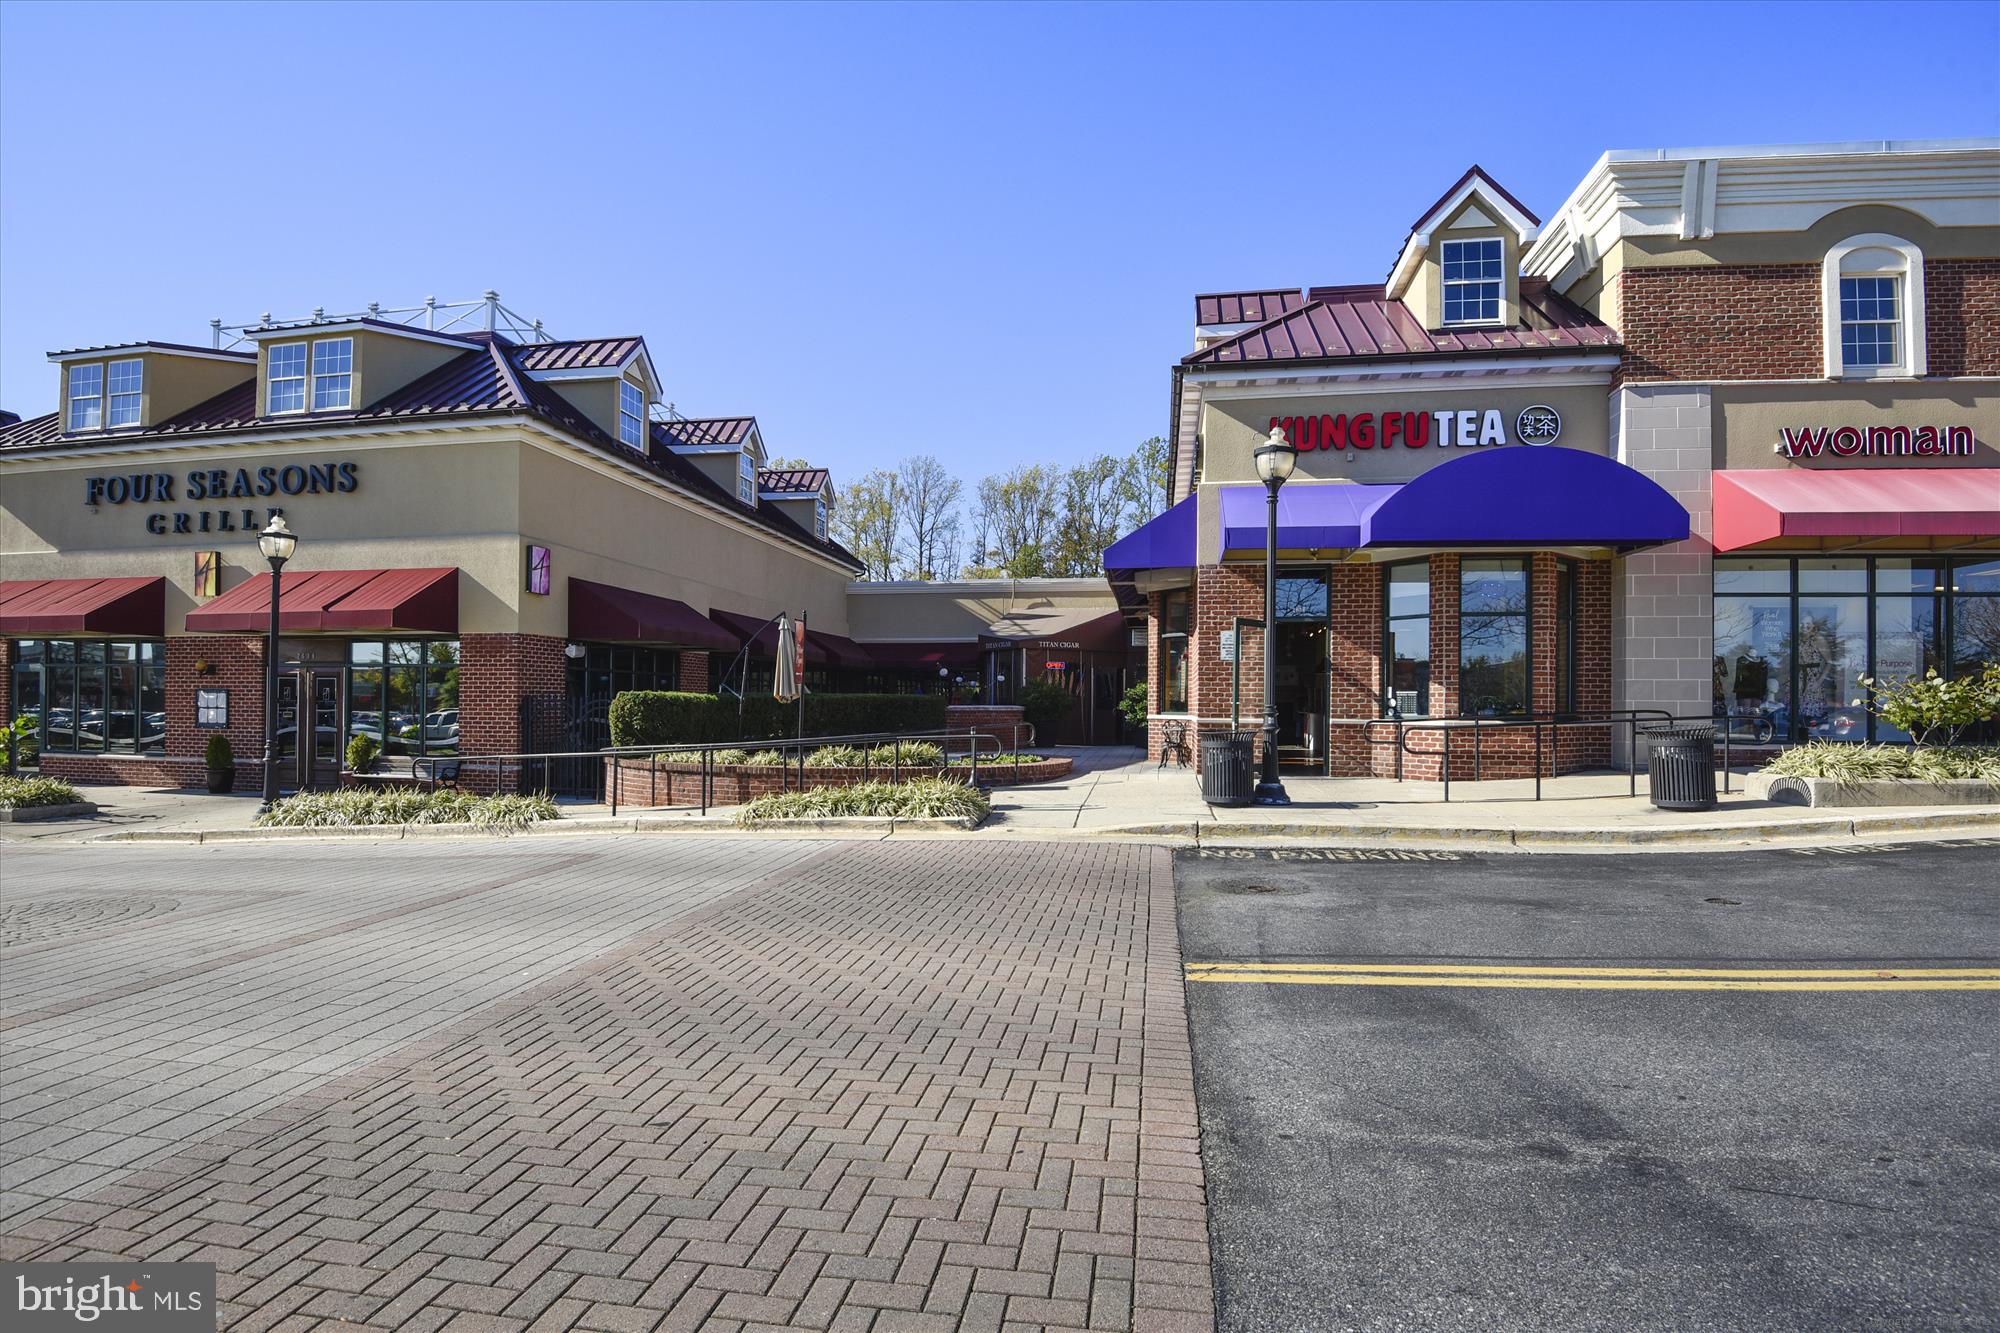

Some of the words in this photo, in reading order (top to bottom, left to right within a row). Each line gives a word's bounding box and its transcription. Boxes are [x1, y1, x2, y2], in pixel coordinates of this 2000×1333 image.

[1381, 411, 1430, 449] FU
[1434, 409, 1506, 447] TEA
[1779, 425, 1976, 458] woman
[85, 473, 175, 506] FOUR
[187, 462, 358, 500] SEASONS
[1046, 661, 1065, 669] OPEN
[1199, 848, 1256, 858] NO
[1270, 849, 1460, 861] PARKING
